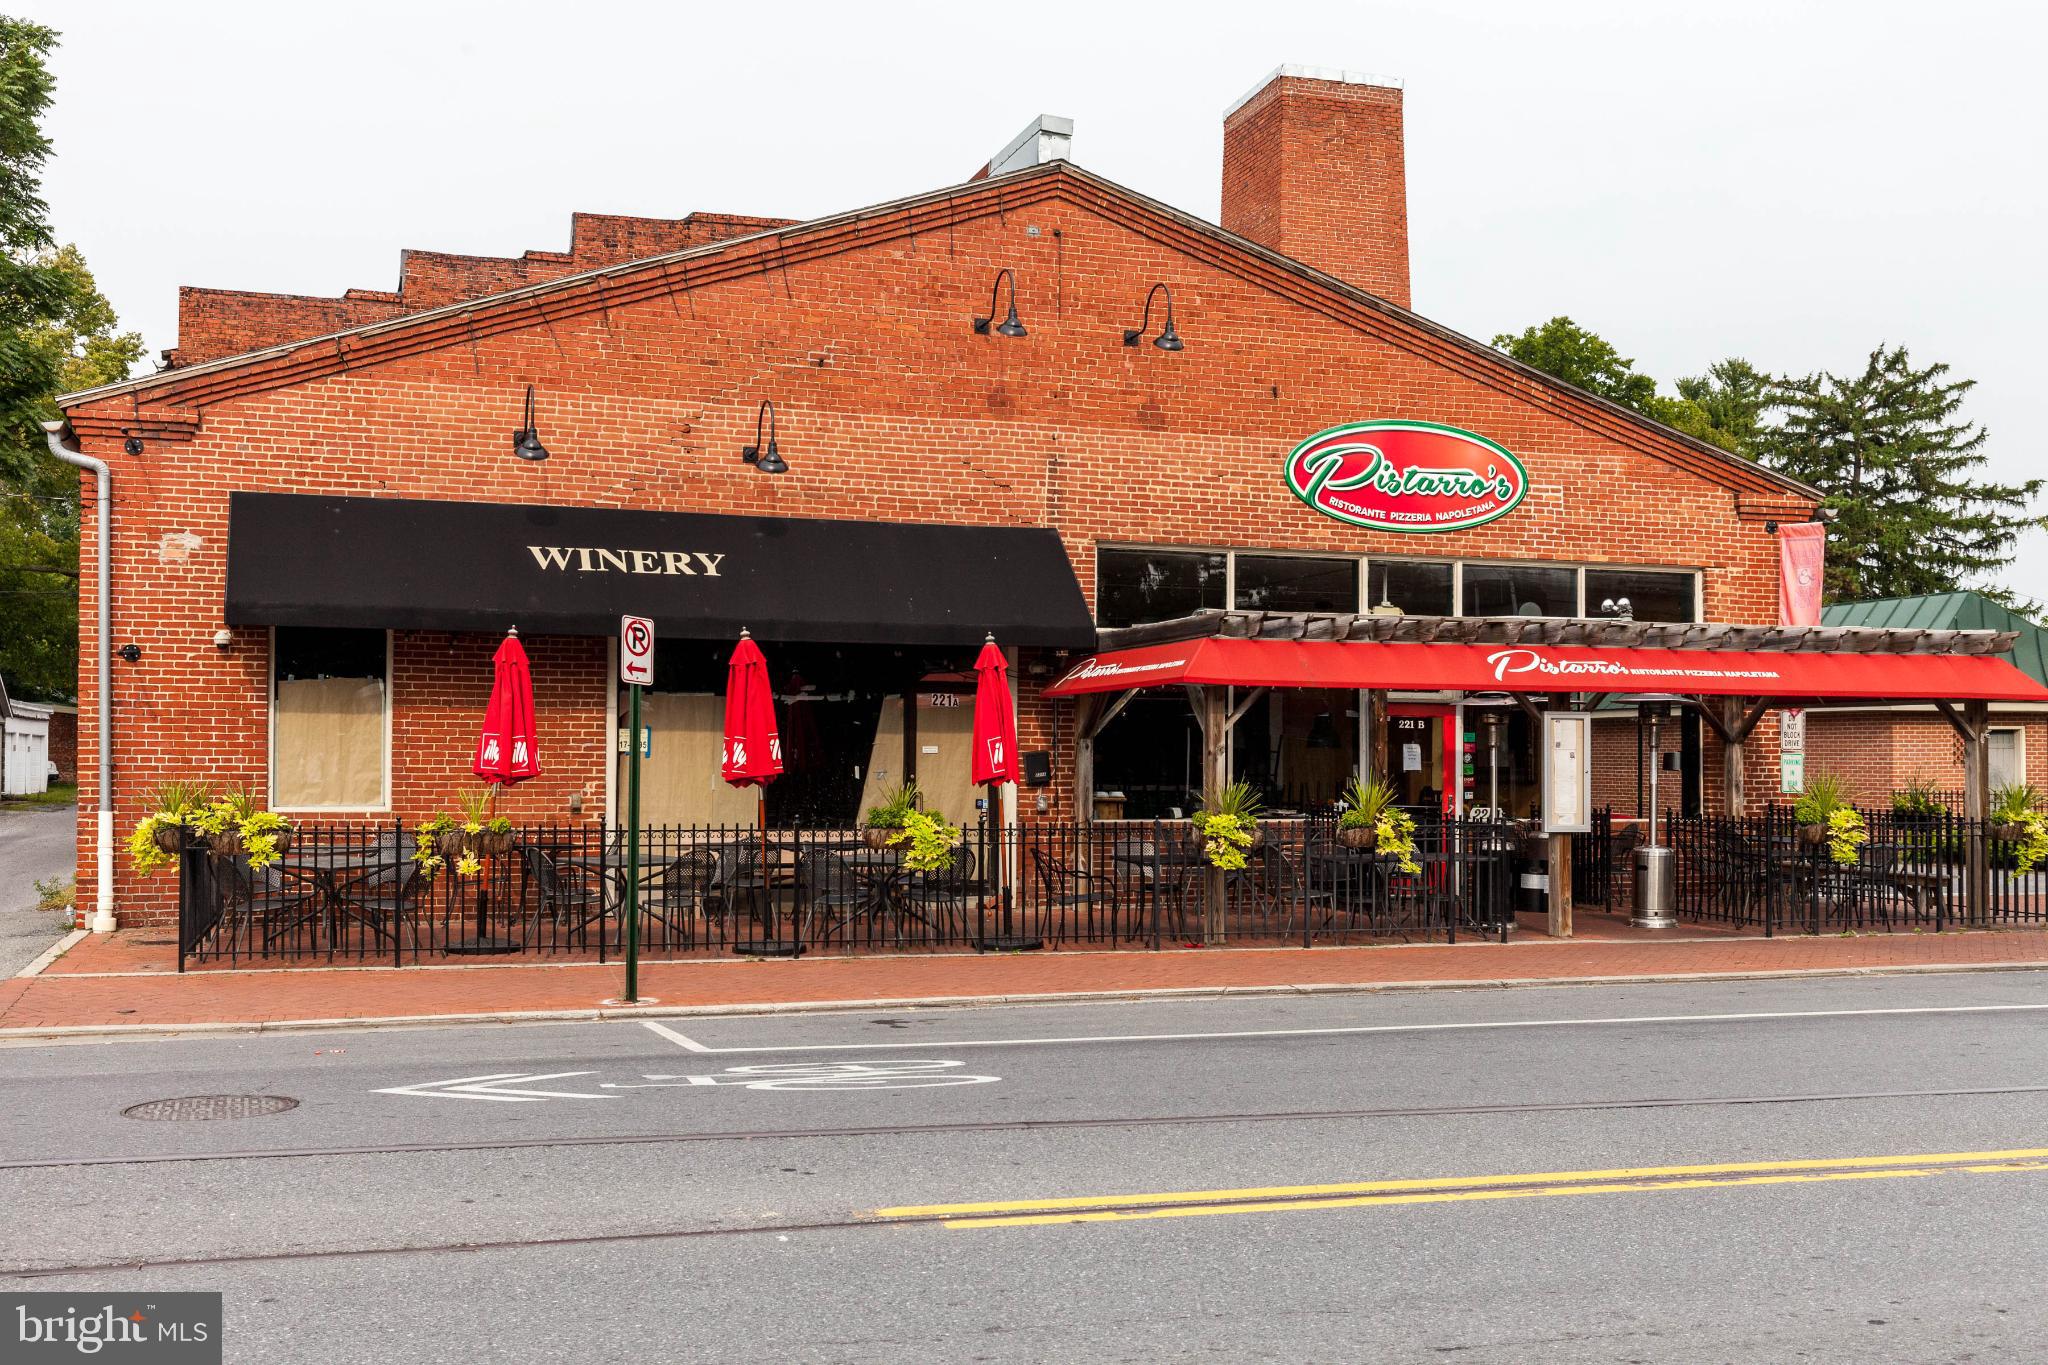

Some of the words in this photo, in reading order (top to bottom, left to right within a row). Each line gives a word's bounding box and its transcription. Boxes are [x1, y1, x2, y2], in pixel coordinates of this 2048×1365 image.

[1304, 443, 1513, 504] Pistarro's
[1329, 496, 1386, 520] RISTORANTE
[1390, 511, 1432, 522] PIZZERIA
[1435, 501, 1496, 521] NAPOLETANA
[526, 546, 726, 577] WINERY
[1487, 649, 1629, 681] Pistarro's
[1630, 668, 1685, 676] RISTORANTE
[1684, 669, 1724, 677] PIZZERIA
[1398, 720, 1415, 729] 221
[1418, 720, 1425, 729] B
